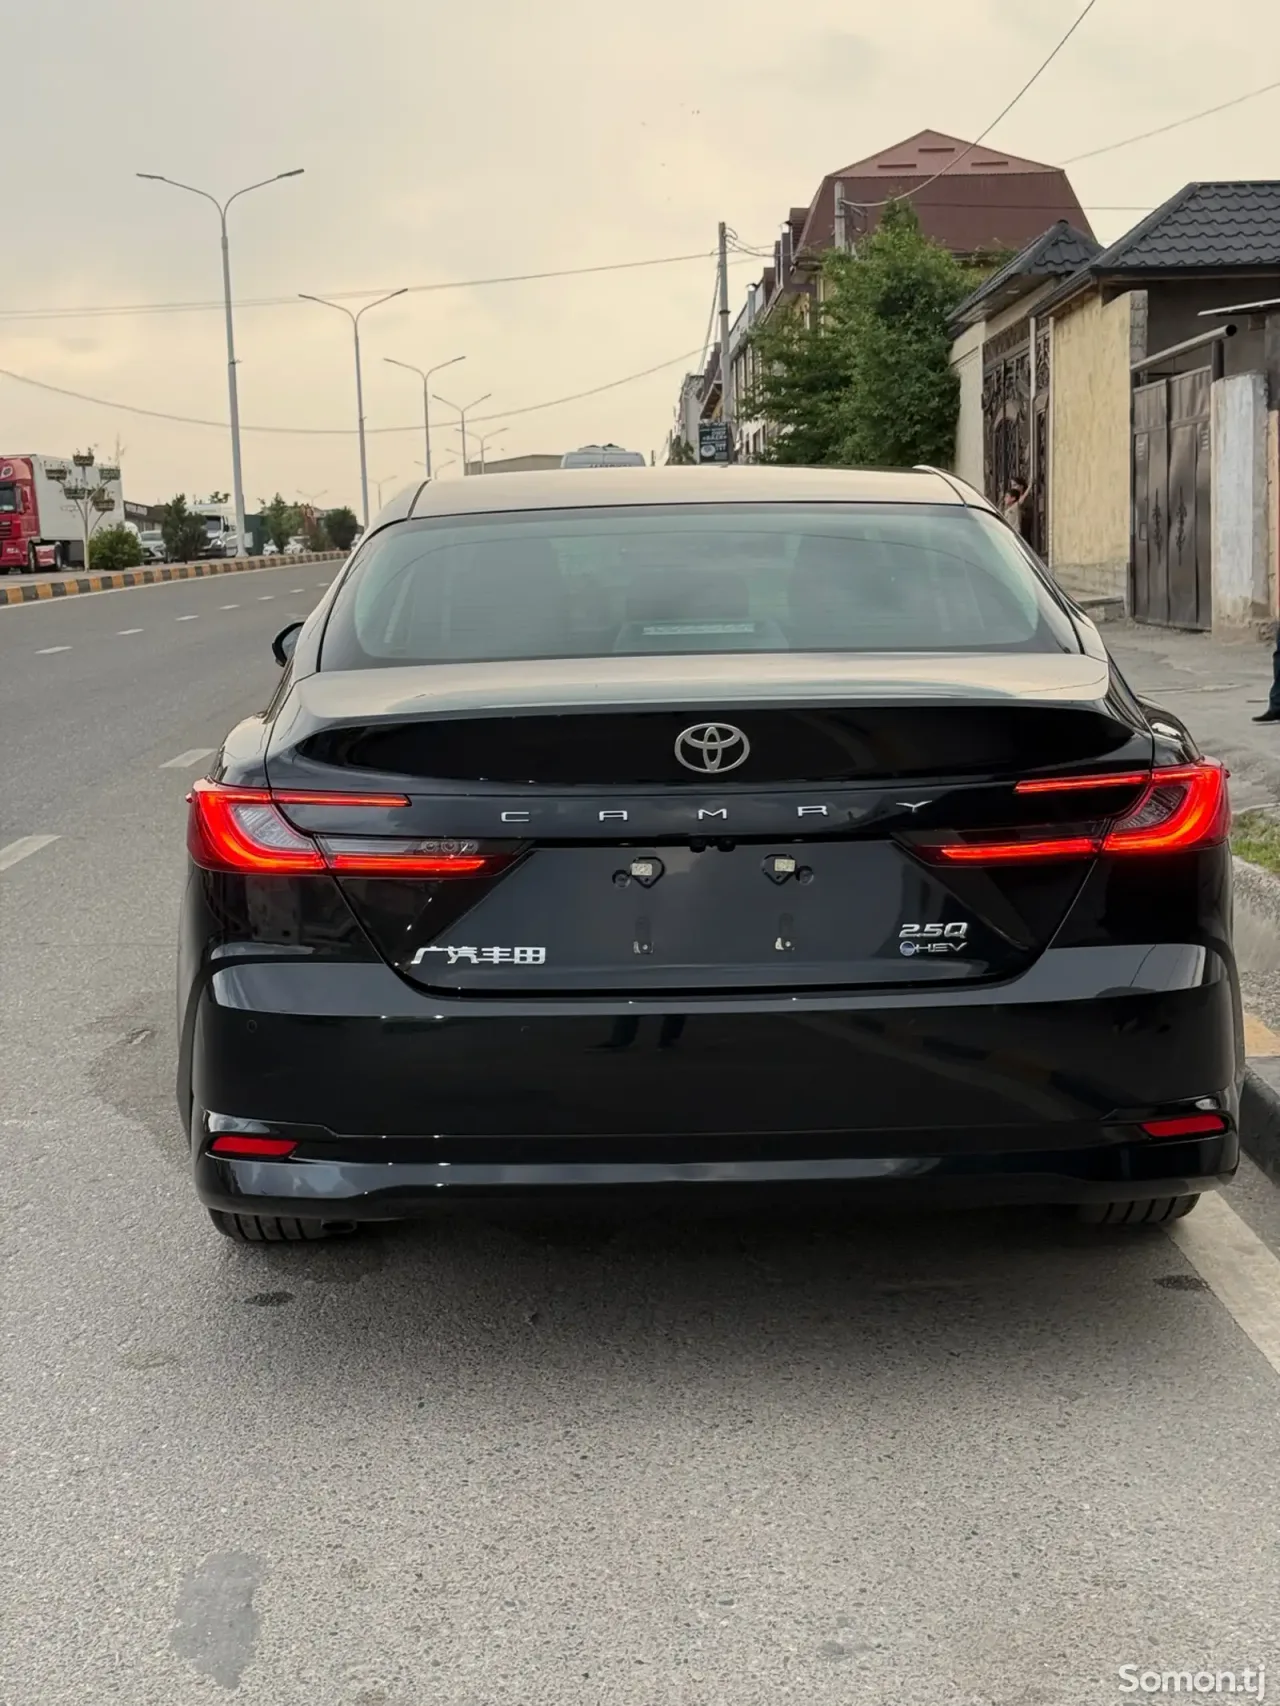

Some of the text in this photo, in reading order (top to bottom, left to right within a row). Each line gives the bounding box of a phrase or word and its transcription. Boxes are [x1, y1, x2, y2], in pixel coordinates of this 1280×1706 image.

[501, 800, 932, 822] CAMRY
[410, 946, 547, 965] 广汽丰田
[916, 942, 967, 953] HEV
